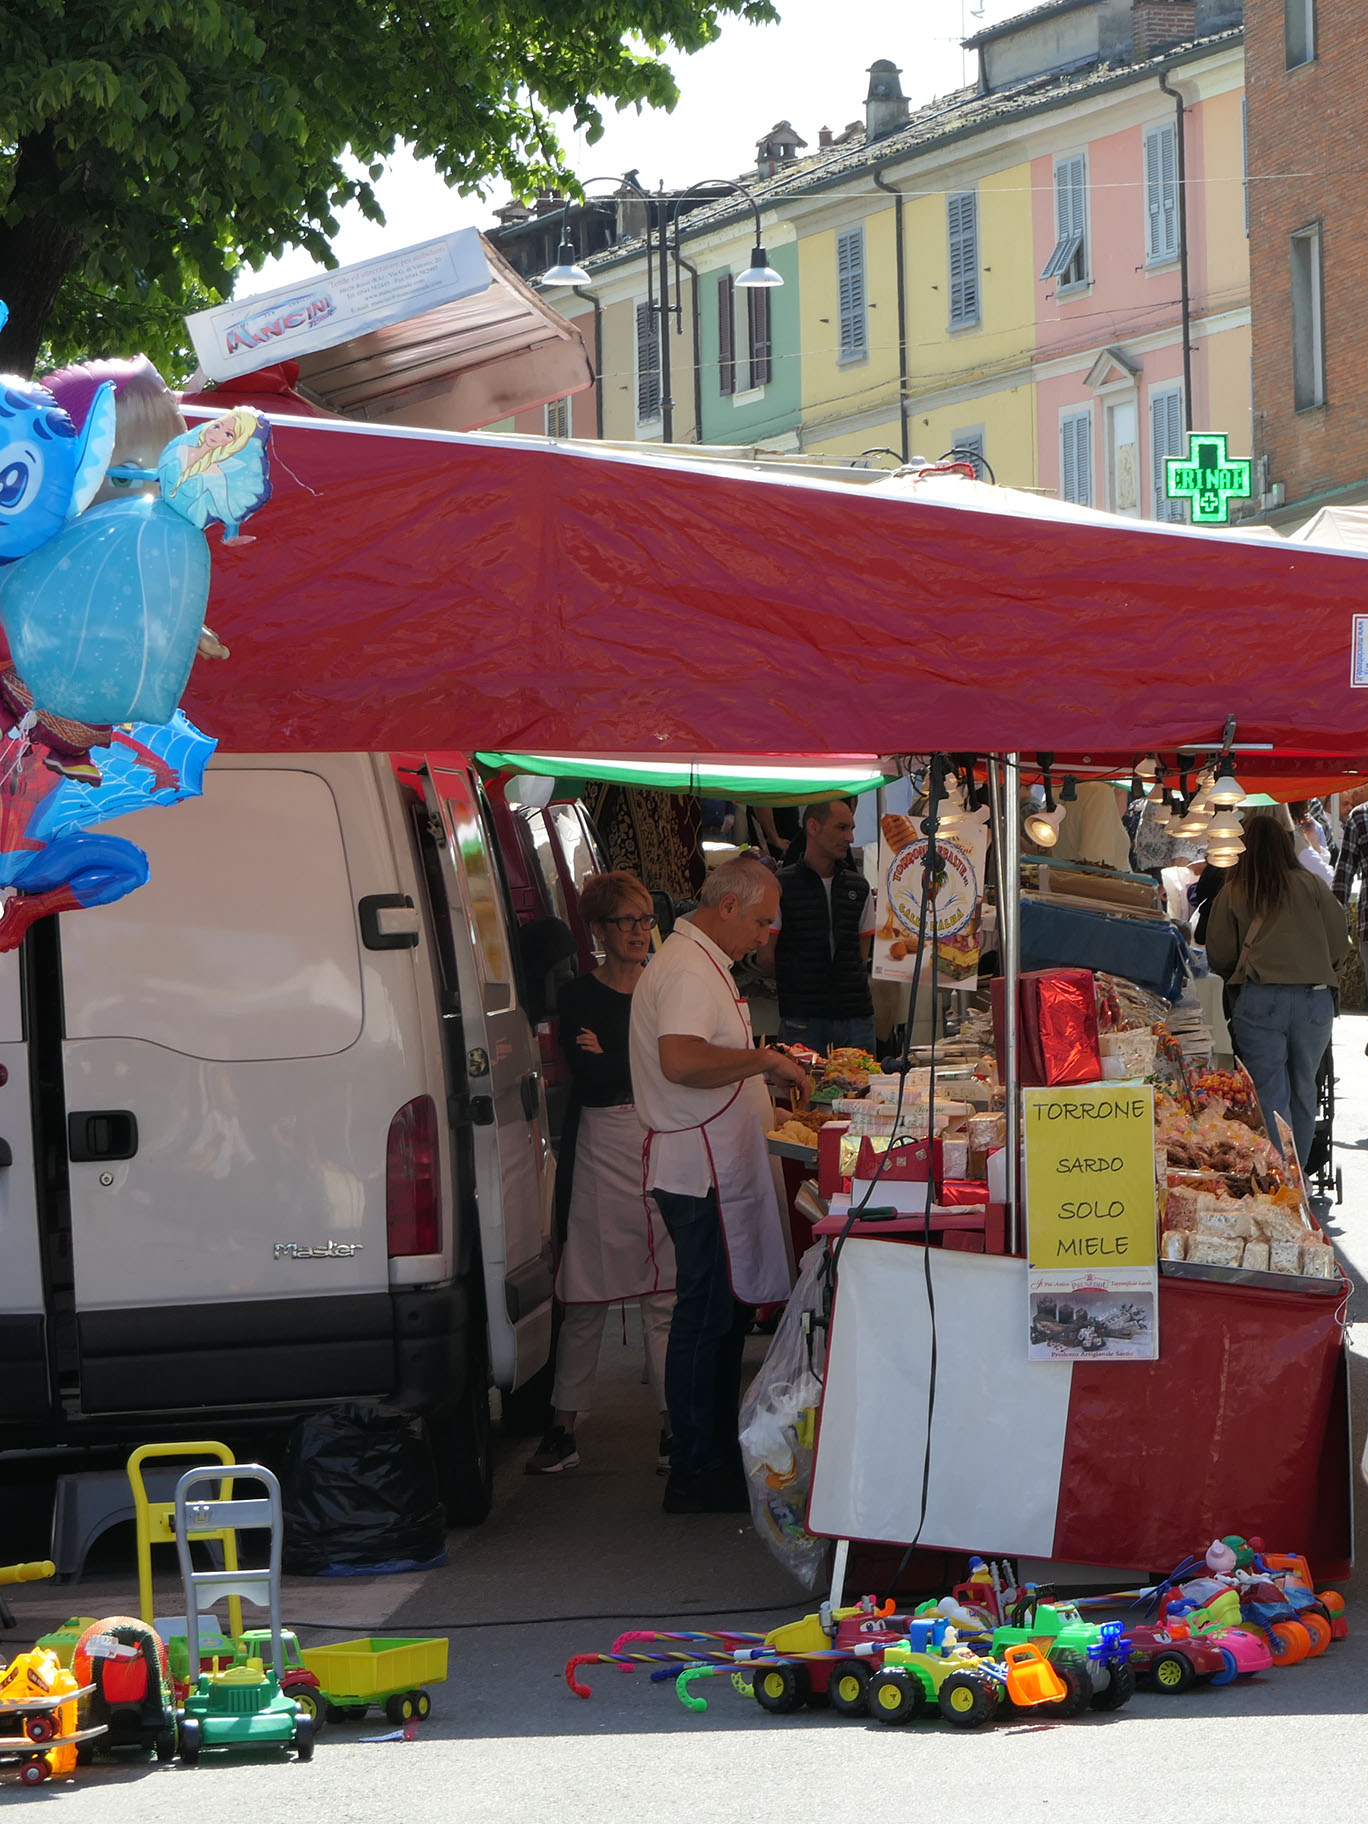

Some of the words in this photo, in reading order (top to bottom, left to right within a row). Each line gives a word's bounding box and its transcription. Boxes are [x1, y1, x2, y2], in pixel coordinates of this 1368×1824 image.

[1033, 1100, 1145, 1121] TORRONE
[1056, 1157, 1124, 1174] SARDO
[1058, 1201, 1125, 1219] SOLO
[274, 1240, 364, 1260] Master
[1057, 1236, 1129, 1256] MIELE
